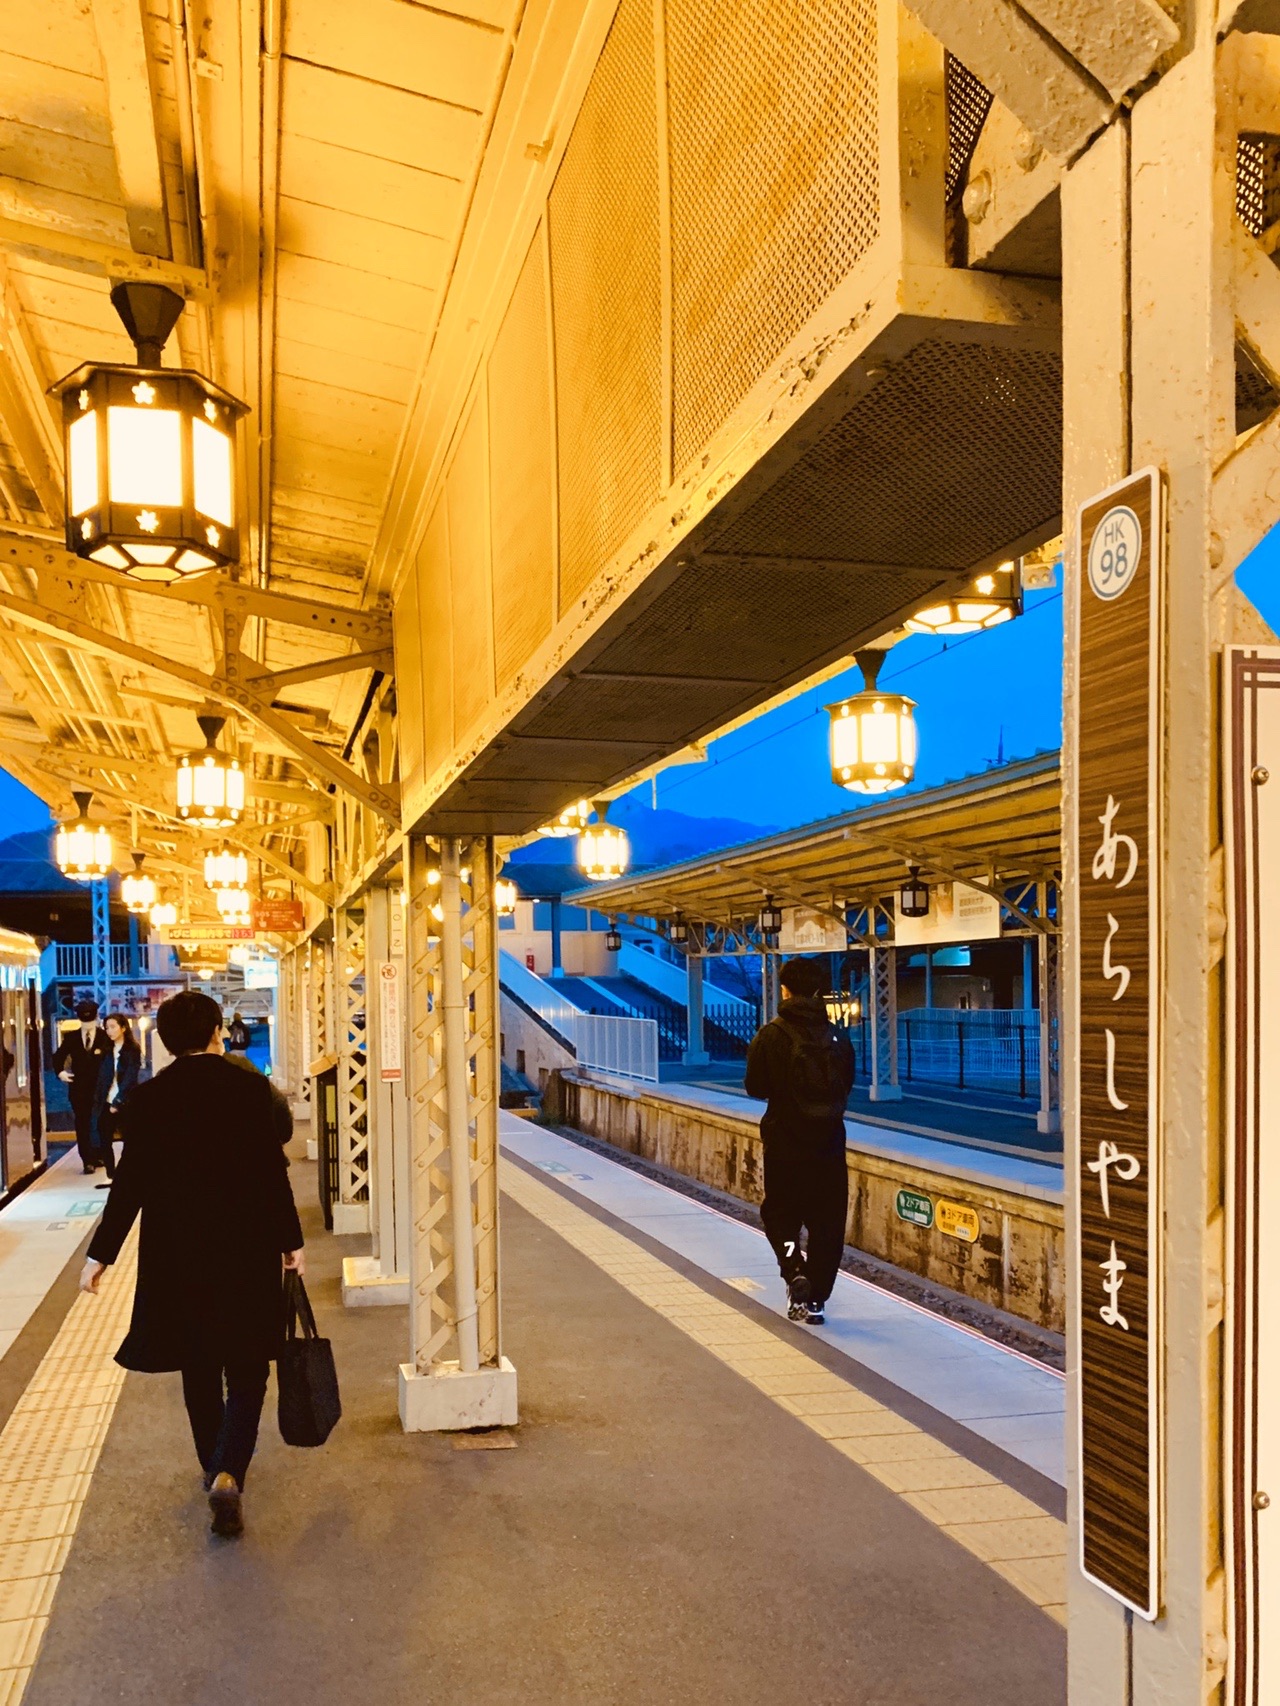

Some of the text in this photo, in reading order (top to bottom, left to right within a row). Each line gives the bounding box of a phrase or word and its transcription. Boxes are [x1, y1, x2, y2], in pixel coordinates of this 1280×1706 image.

[1104, 517, 1125, 547] HK
[1100, 542, 1128, 585] 98
[1086, 793, 1141, 1332] あらしやま
[783, 1241, 795, 1257] 7
